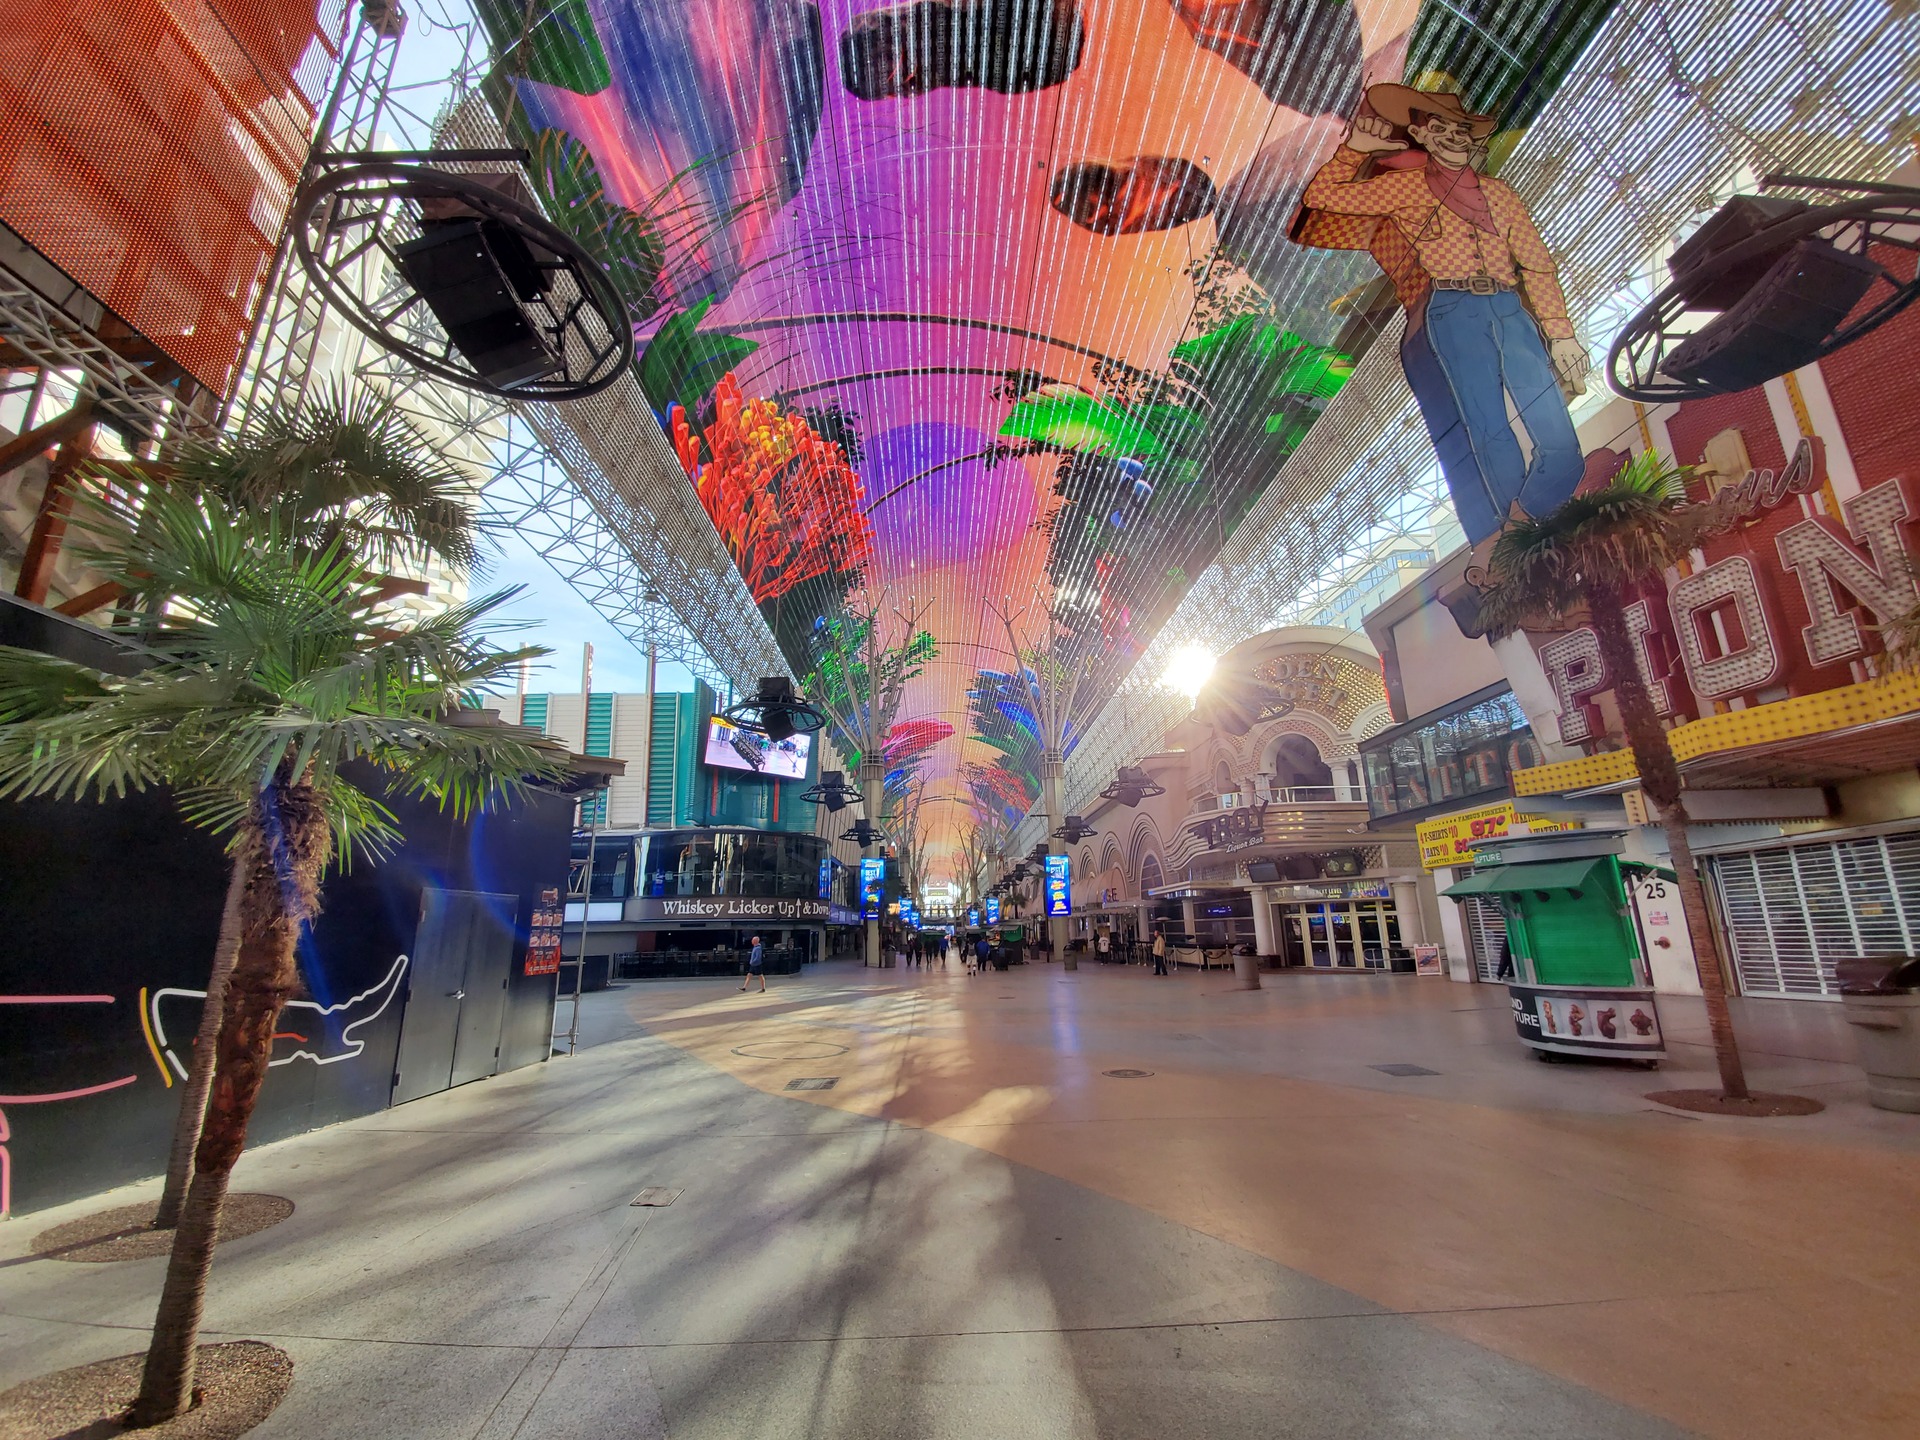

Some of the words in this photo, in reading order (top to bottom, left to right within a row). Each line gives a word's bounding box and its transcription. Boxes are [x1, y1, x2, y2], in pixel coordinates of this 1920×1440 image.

[1188, 800, 1269, 850] TROY
[1249, 836, 1264, 847] Bar
[1424, 828, 1449, 842] T-SHIRTS
[1644, 882, 1666, 899] 25
[662, 899, 725, 917] Whiskey
[727, 899, 775, 915] Licker
[778, 901, 795, 917] Up
[803, 901, 812, 914] &
